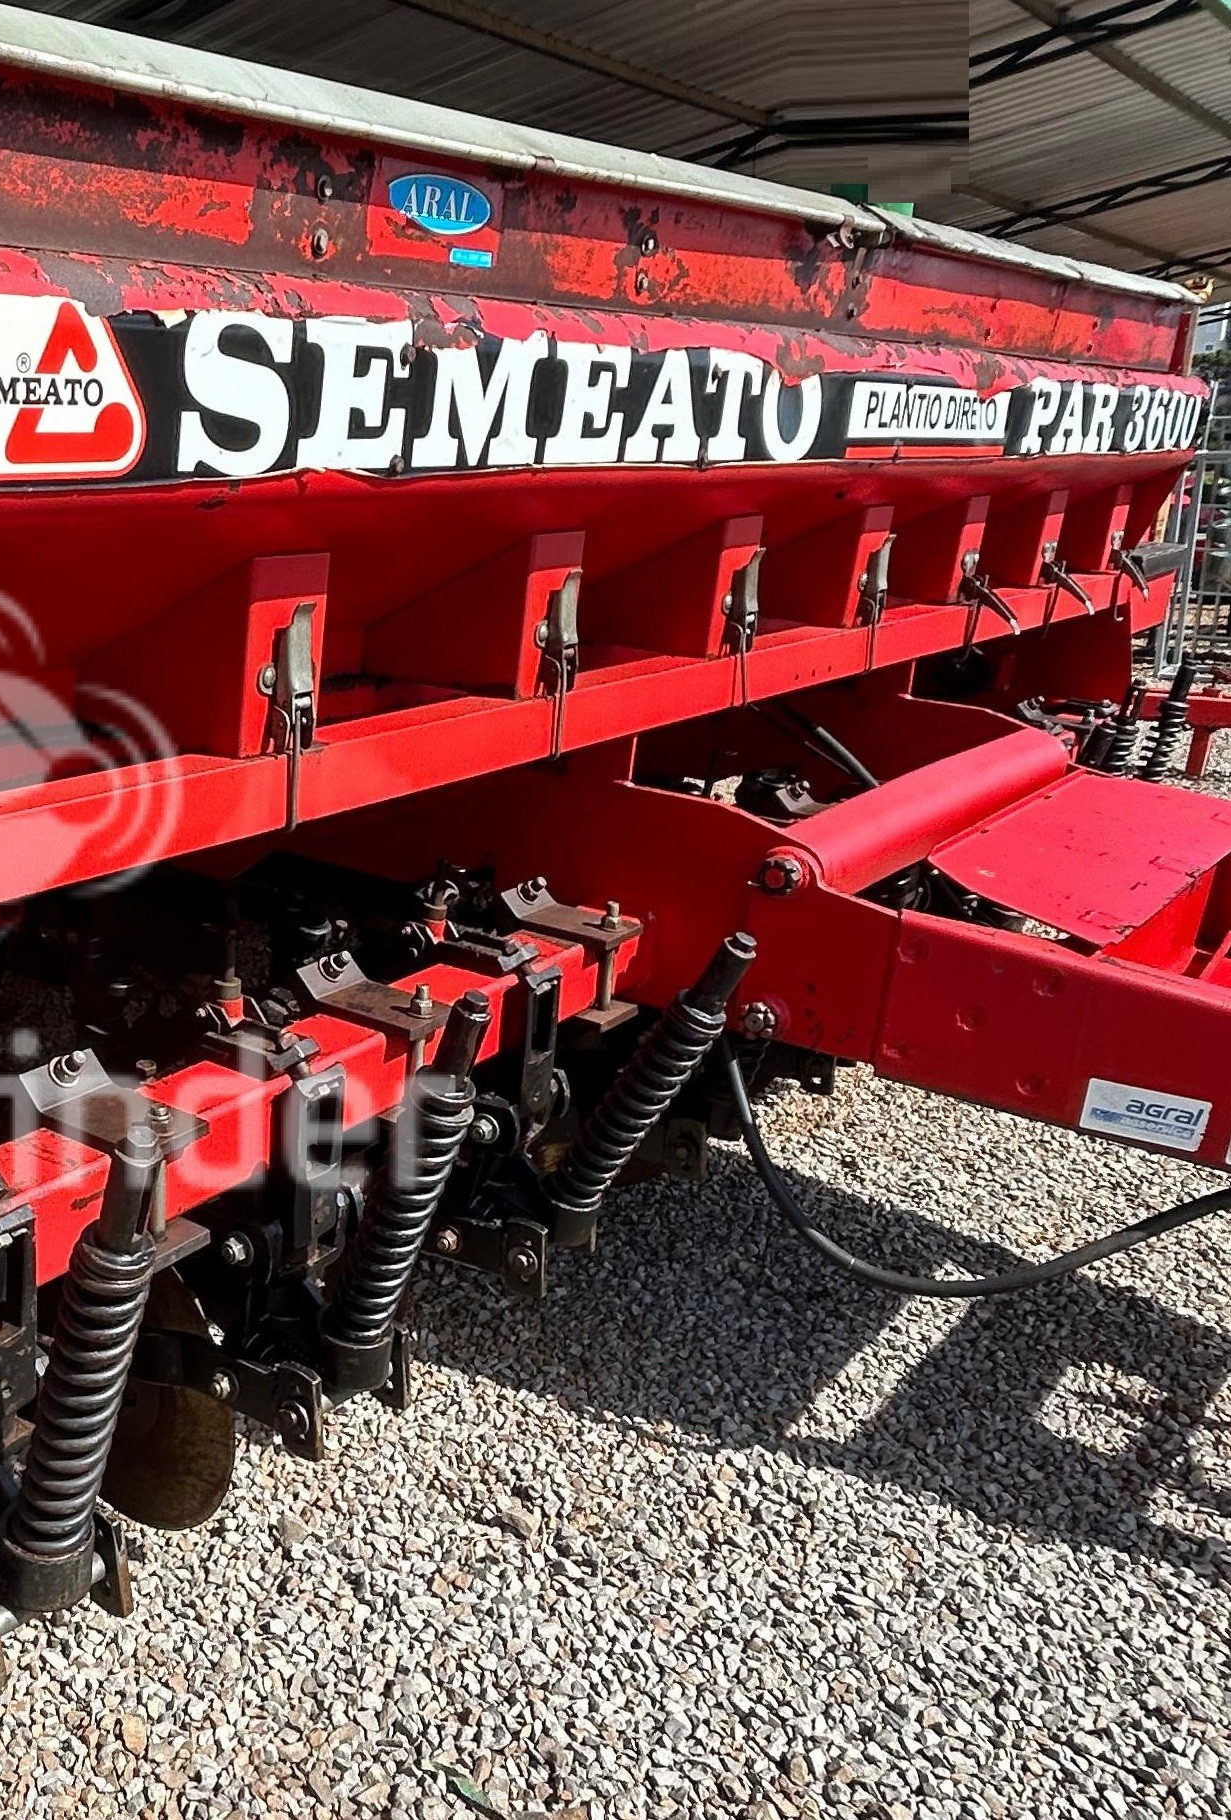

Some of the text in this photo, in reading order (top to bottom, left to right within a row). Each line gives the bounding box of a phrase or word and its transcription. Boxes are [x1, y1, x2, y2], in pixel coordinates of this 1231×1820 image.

[399, 183, 474, 223] ARAL
[177, 310, 822, 476] SEMEATO
[864, 390, 997, 430] PLANTIO DIRETO
[1020, 378, 1202, 454] PAR 3600
